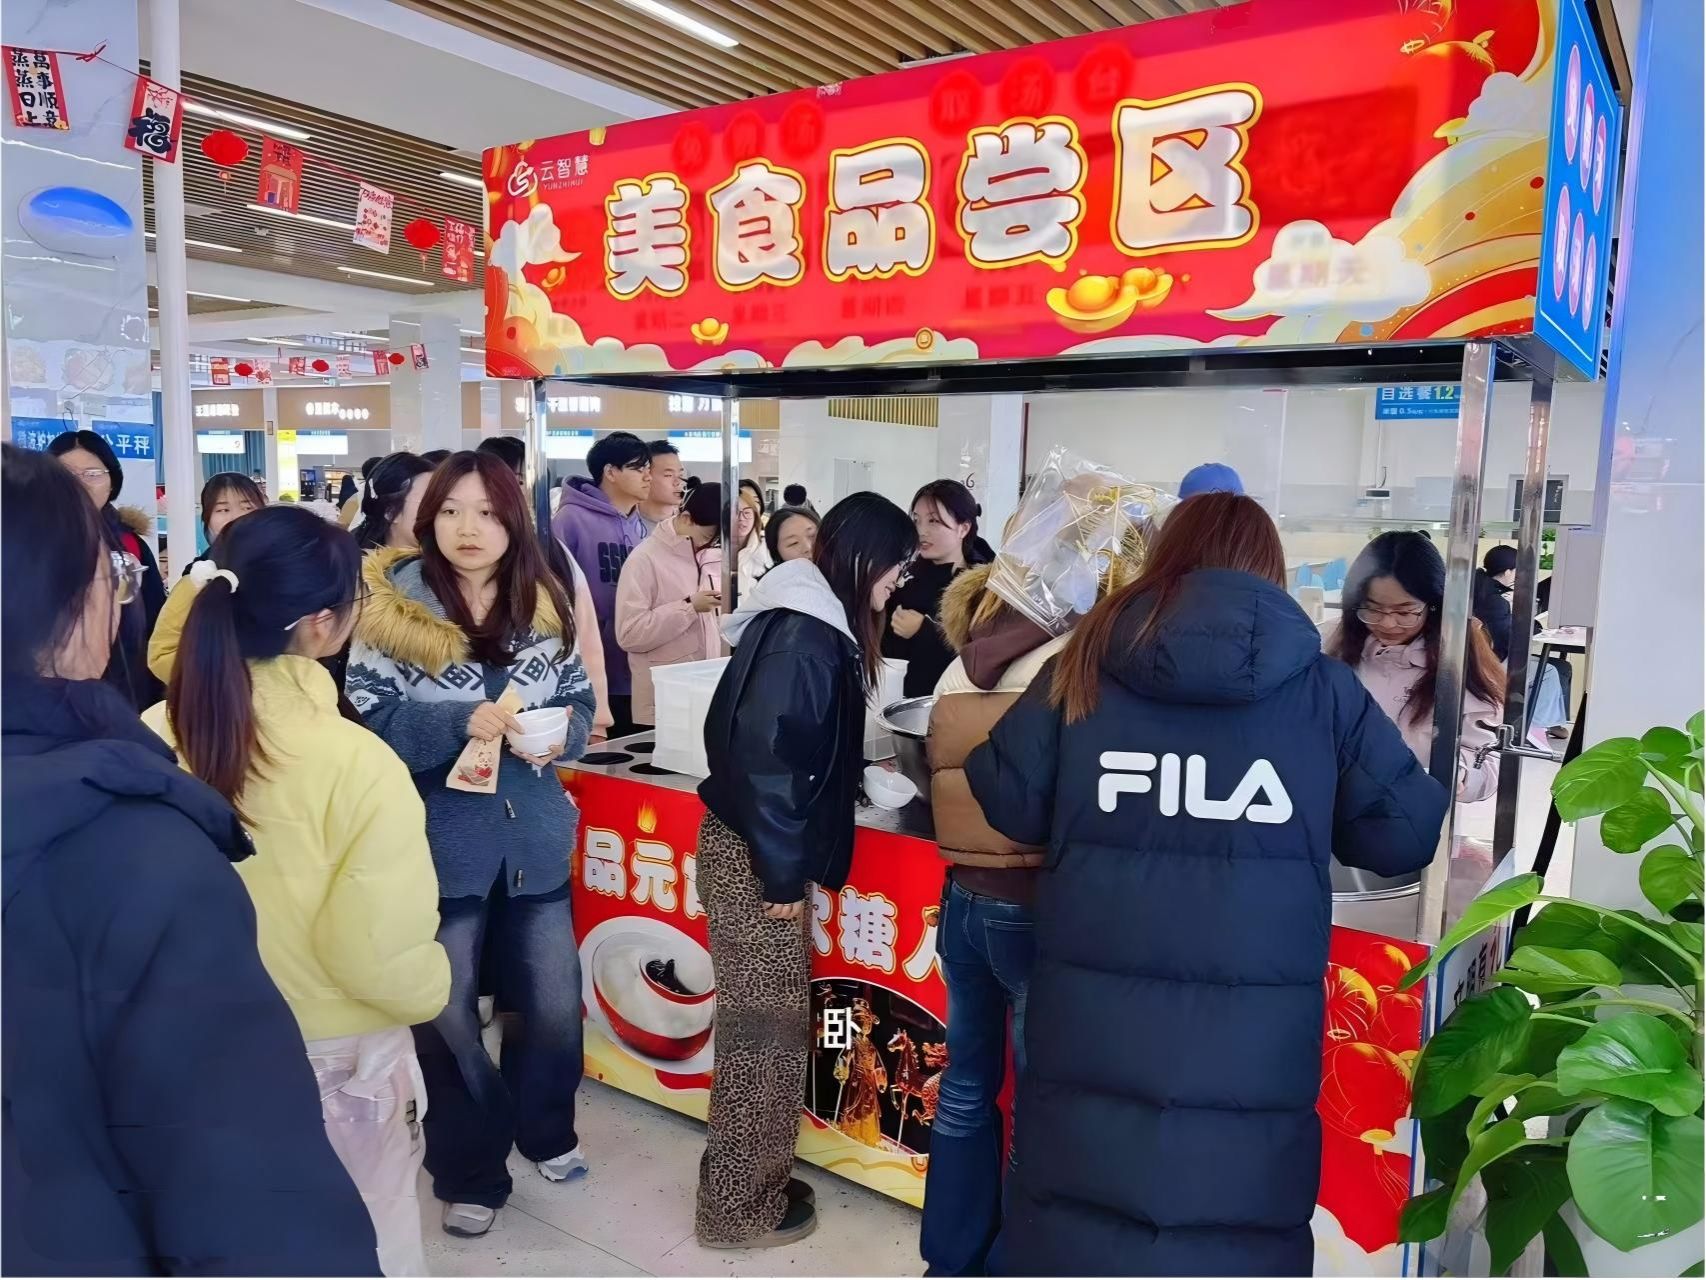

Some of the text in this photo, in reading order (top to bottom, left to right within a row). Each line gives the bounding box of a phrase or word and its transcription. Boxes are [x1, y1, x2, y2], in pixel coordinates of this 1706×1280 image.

[128, 107, 172, 154] 福
[541, 154, 589, 181] 云智慧
[603, 82, 1262, 301] 美食品尝区
[1098, 750, 1294, 825] FILA
